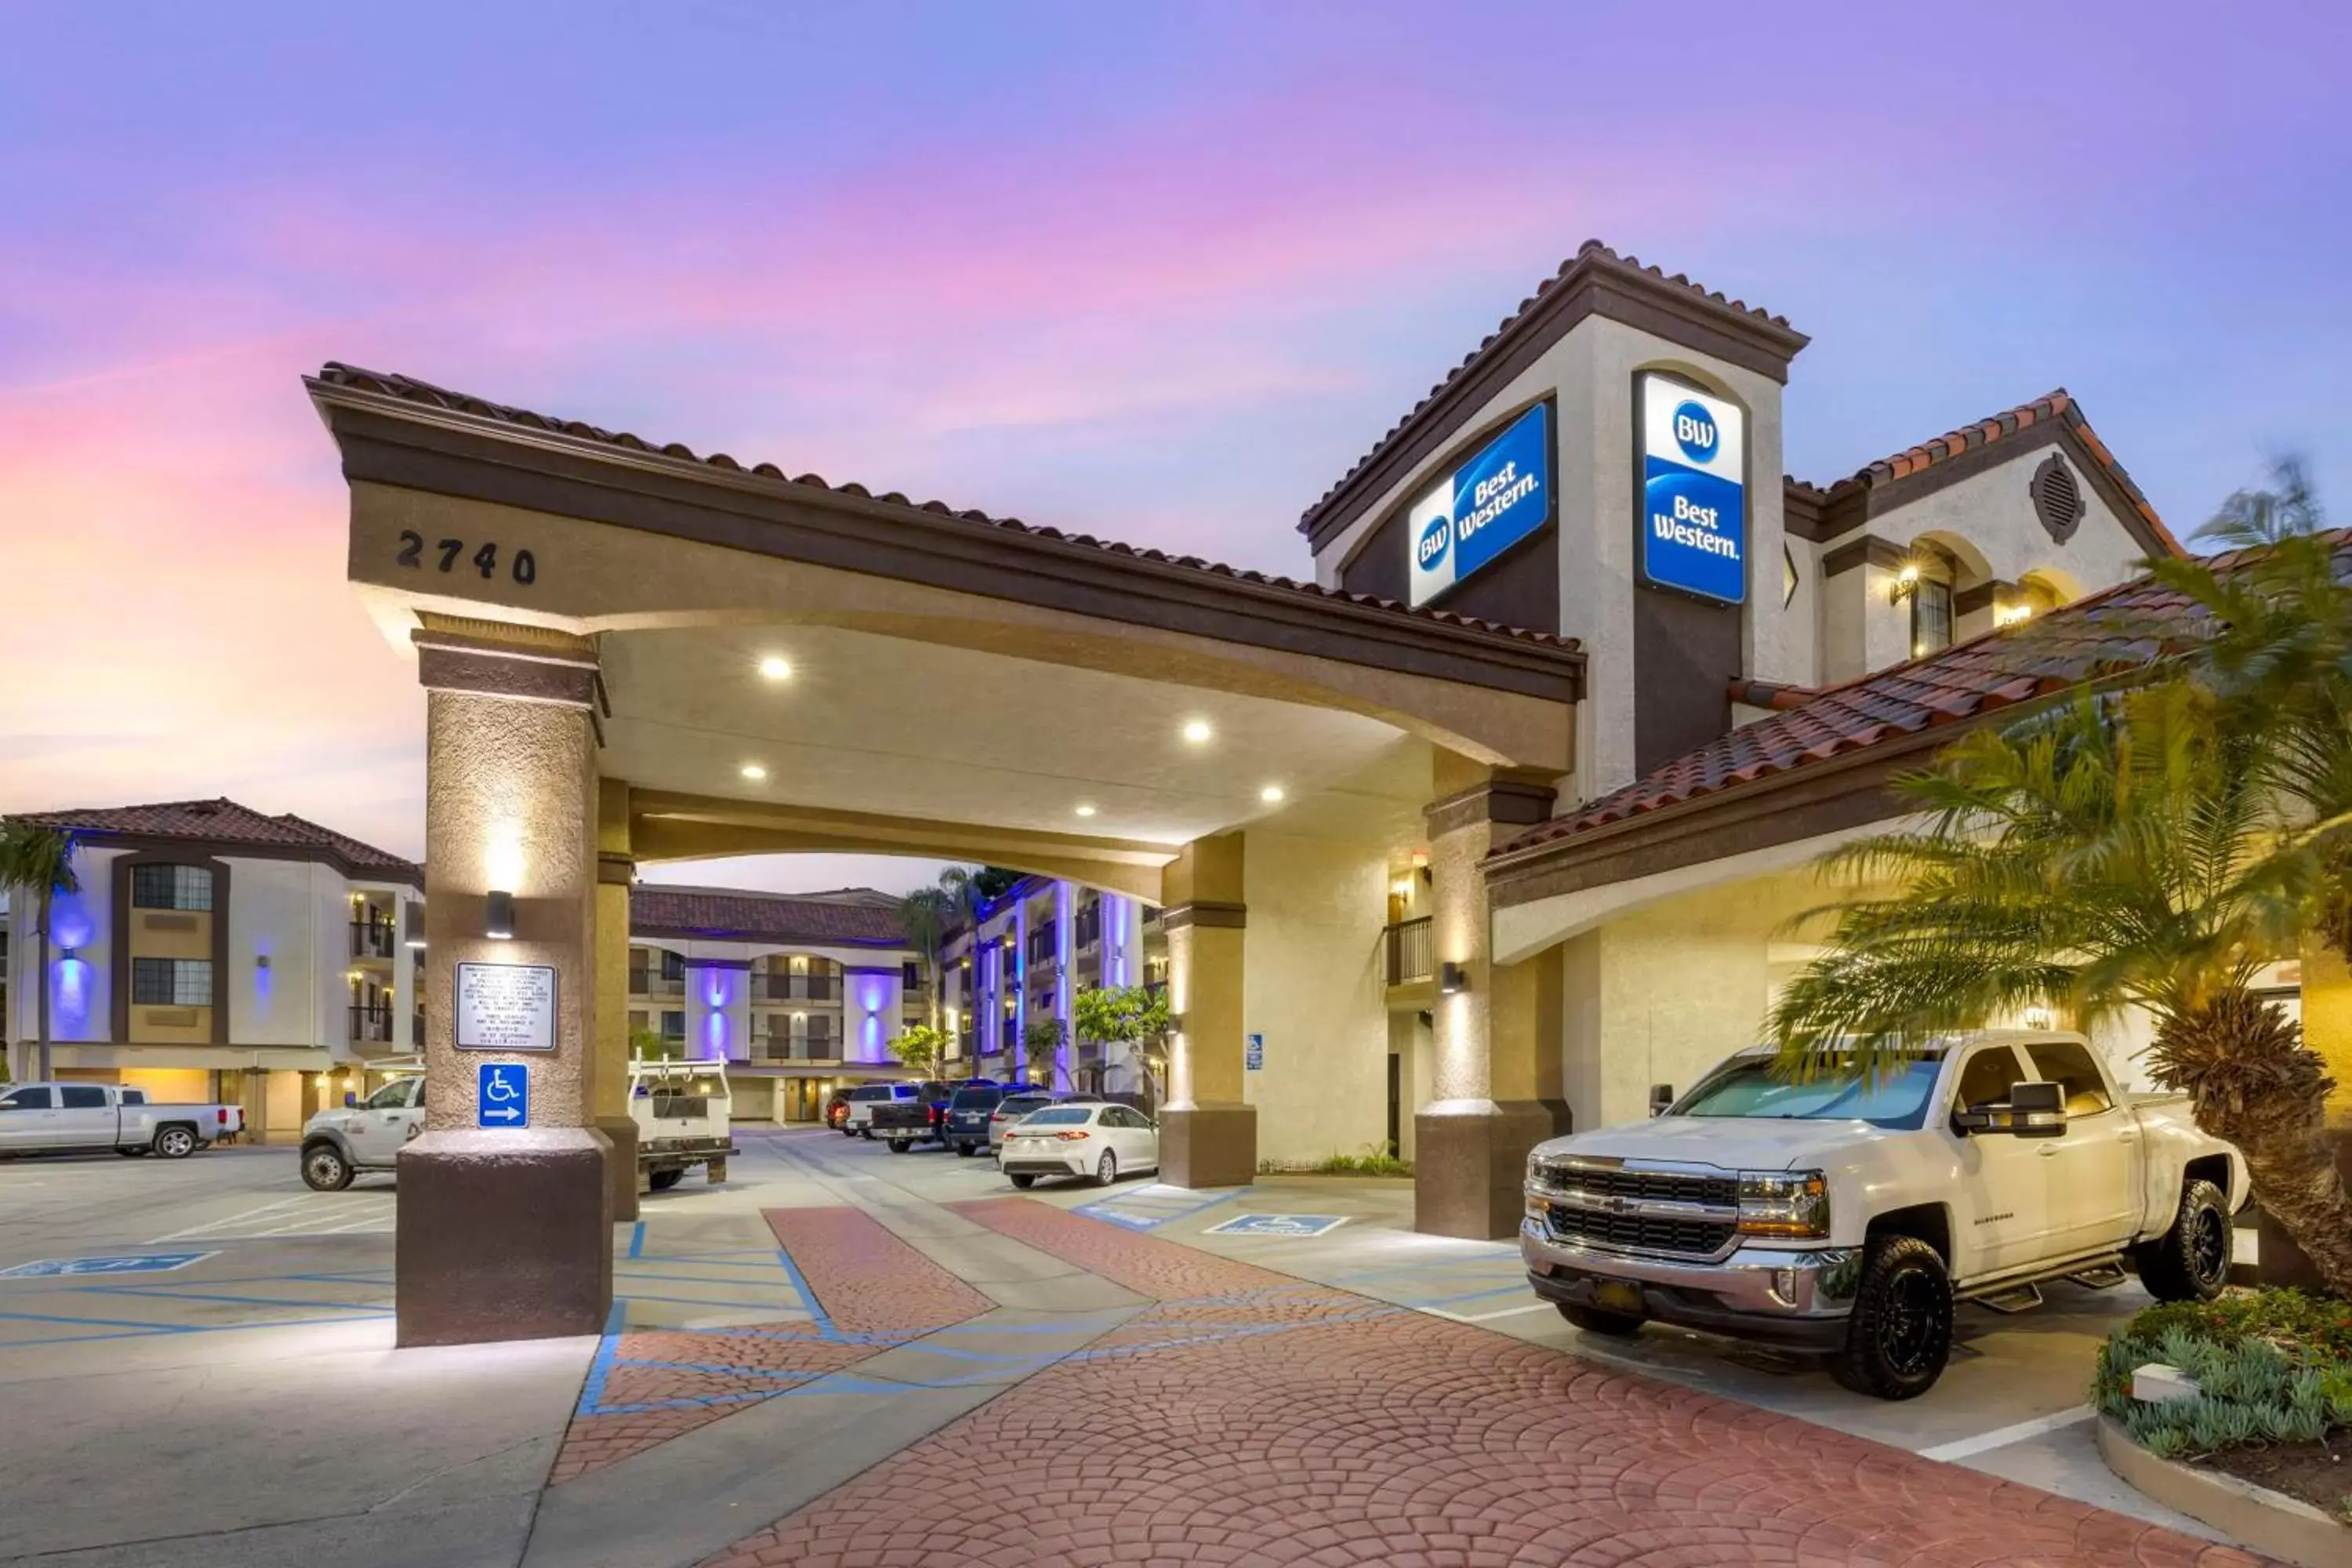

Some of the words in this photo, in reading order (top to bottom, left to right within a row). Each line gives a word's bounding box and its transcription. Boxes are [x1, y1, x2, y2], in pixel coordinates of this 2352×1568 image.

[1677, 414, 1714, 448] BW
[1475, 460, 1516, 507] Best
[1674, 494, 1719, 530] Best
[397, 529, 536, 586] 2740
[1421, 525, 1448, 564] BW
